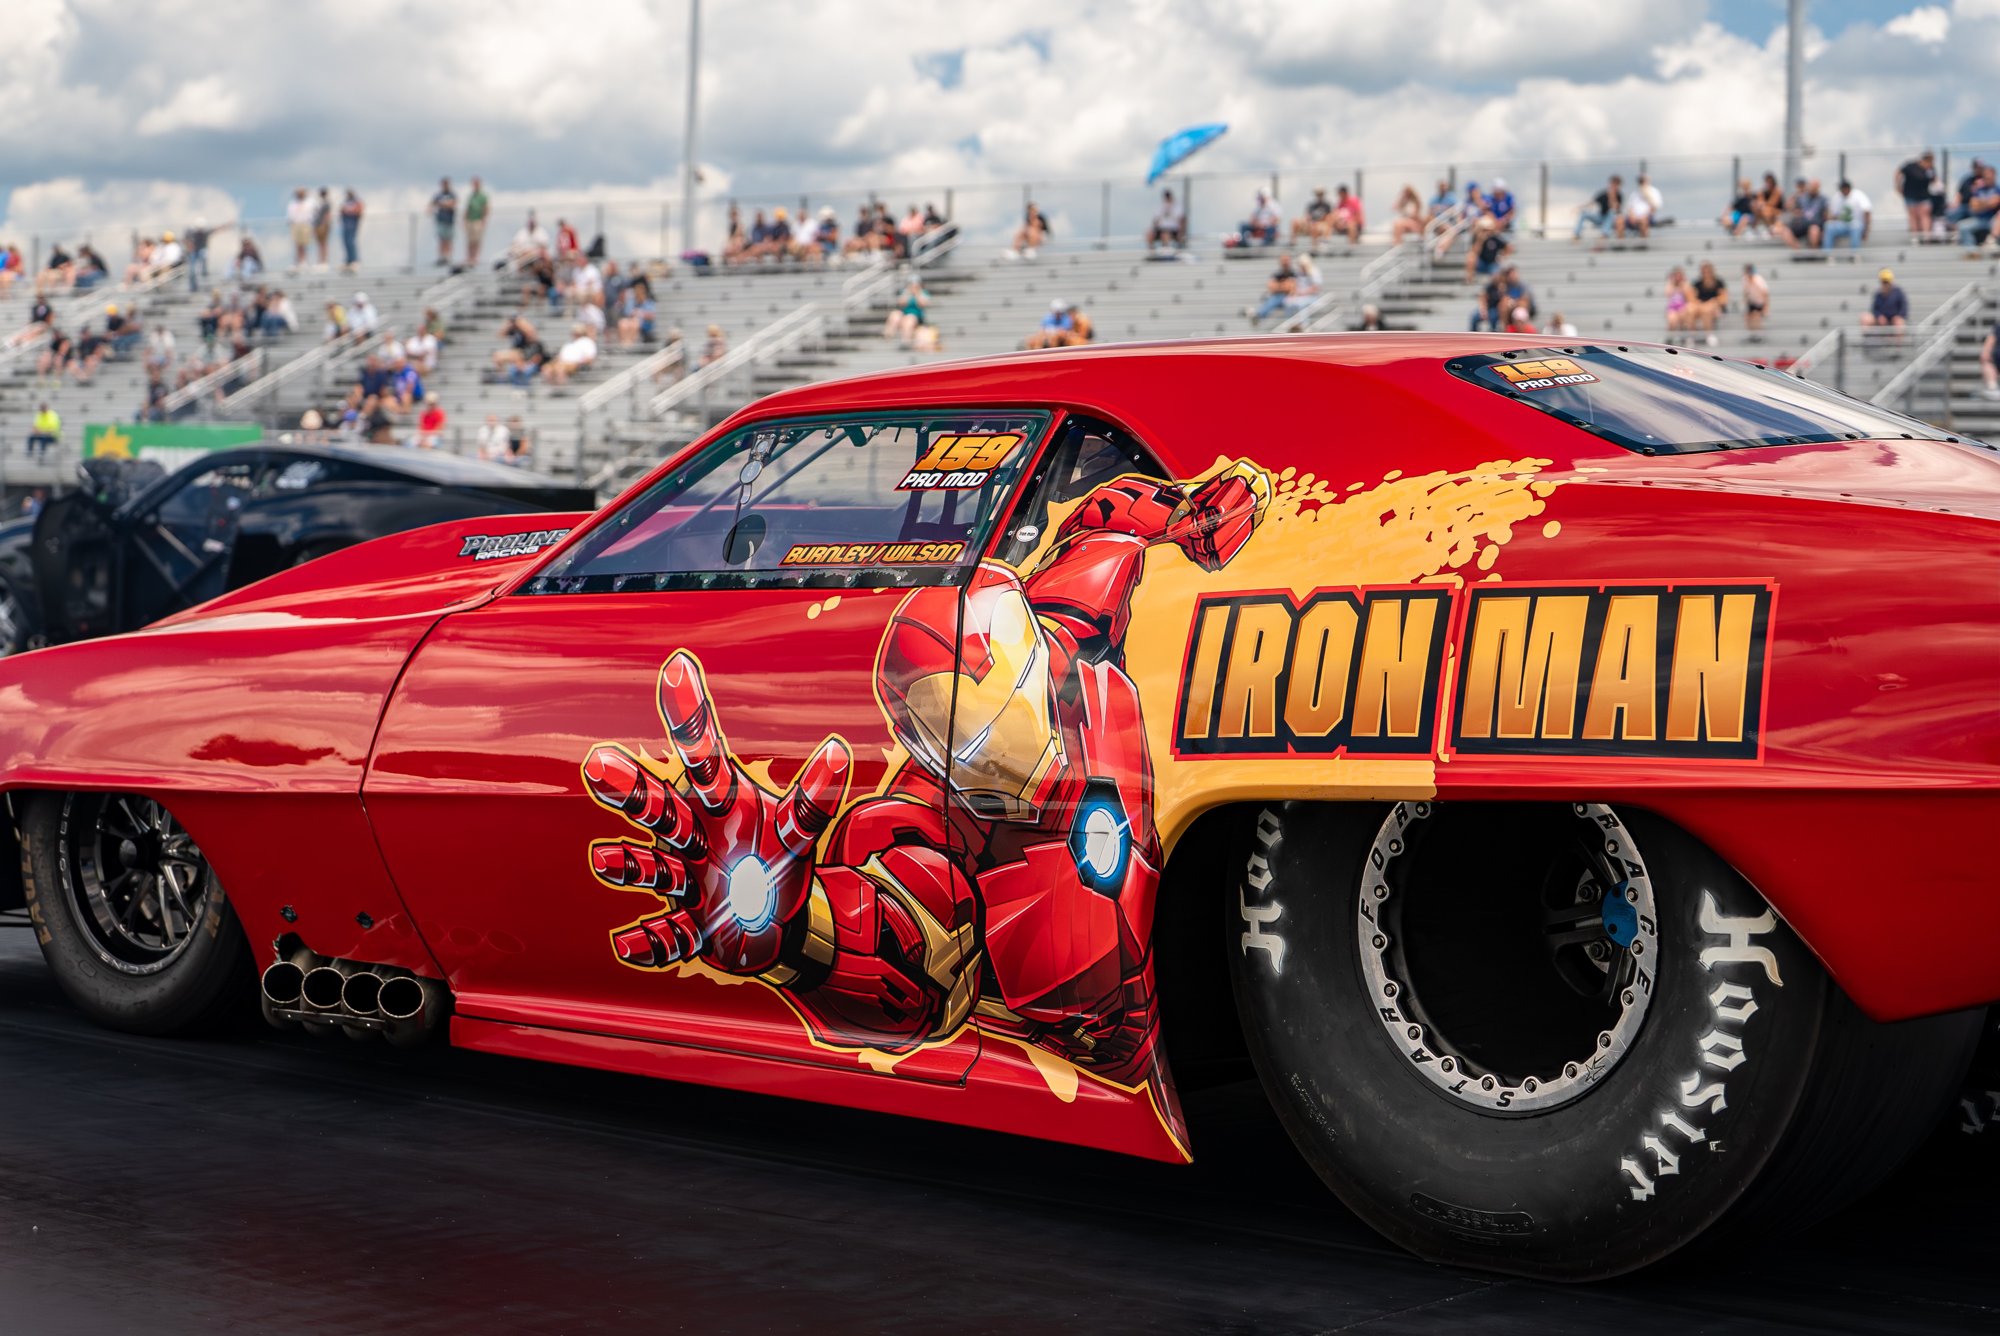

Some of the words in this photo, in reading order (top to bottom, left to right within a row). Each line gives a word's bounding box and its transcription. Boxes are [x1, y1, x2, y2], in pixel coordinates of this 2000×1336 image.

[1492, 359, 1585, 383] 159
[1515, 378, 1555, 391] PRO
[1553, 373, 1597, 386] MOD
[913, 435, 1021, 471] 159
[899, 471, 943, 488] PRO
[939, 471, 989, 488] MOD
[459, 528, 572, 556] PROLINE
[474, 545, 541, 561] RACING
[784, 544, 960, 563] BURNLEY/WILSON
[1184, 598, 1440, 739] IRON
[1460, 594, 1756, 742] MAN
[1379, 1006, 1515, 1109] STAR
[1620, 888, 1784, 1202] Hoosier
